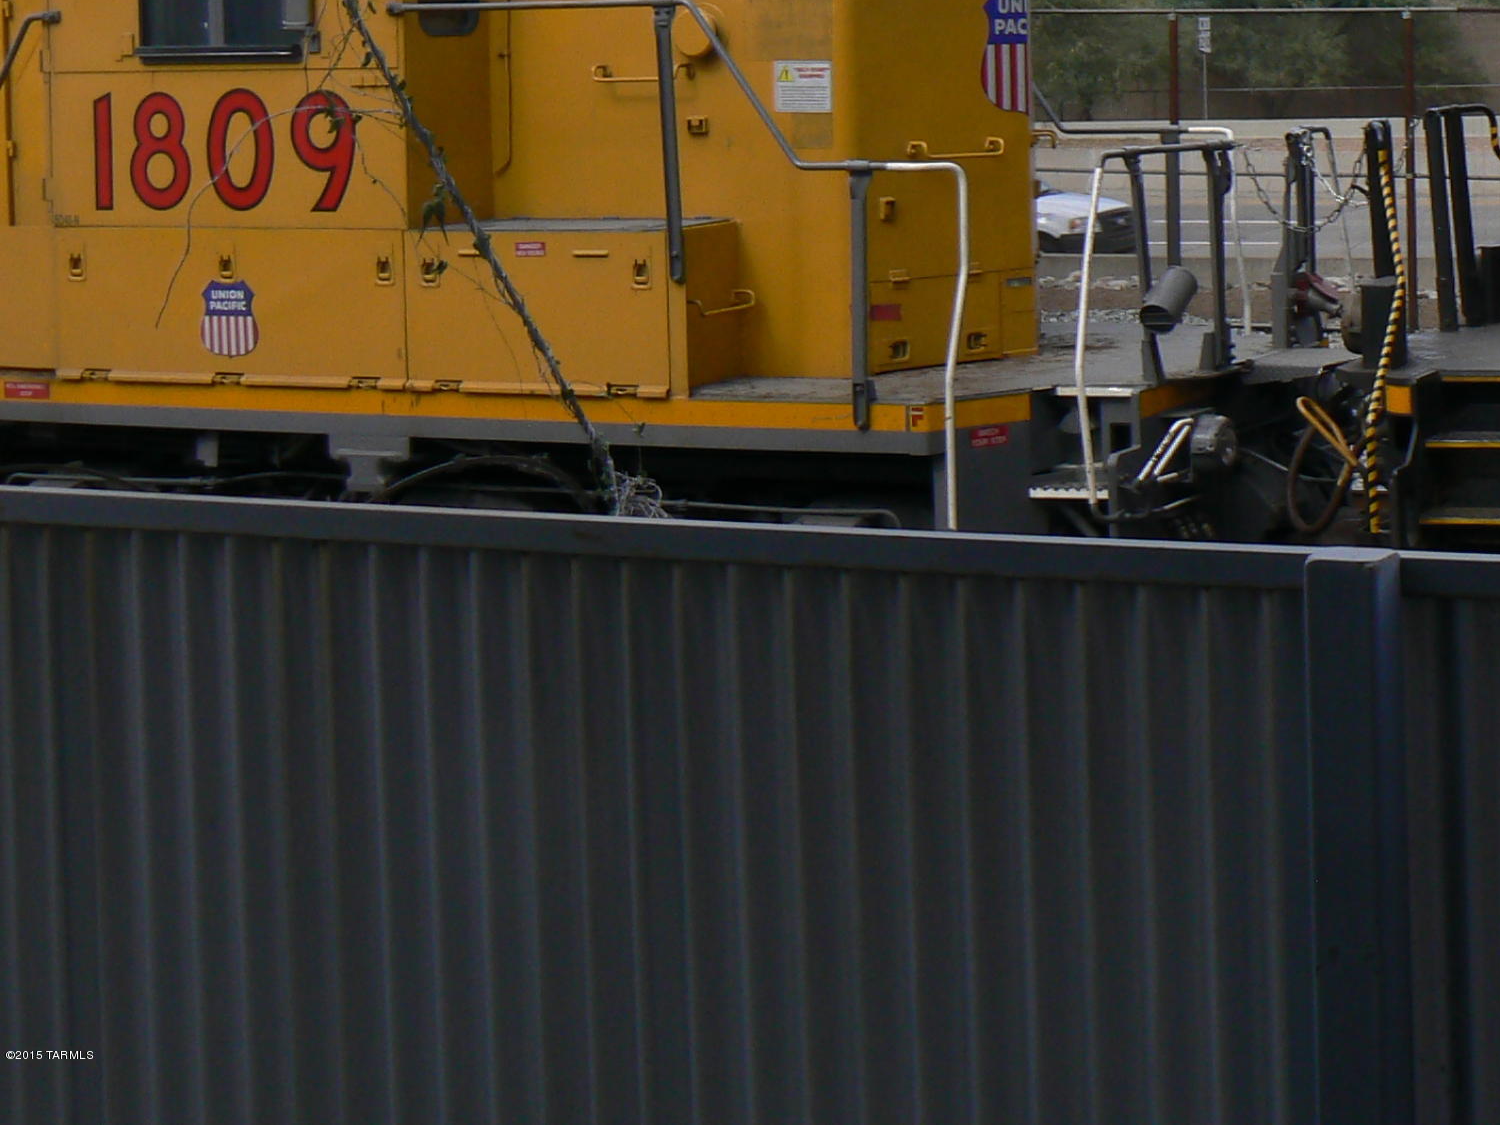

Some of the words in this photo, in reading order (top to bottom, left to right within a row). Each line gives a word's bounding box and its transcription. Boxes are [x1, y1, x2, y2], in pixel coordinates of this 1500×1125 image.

[93, 88, 356, 212] 1809
[211, 290, 245, 299] UNION
[209, 301, 247, 311] PACIFIC
[911, 407, 924, 427] F
